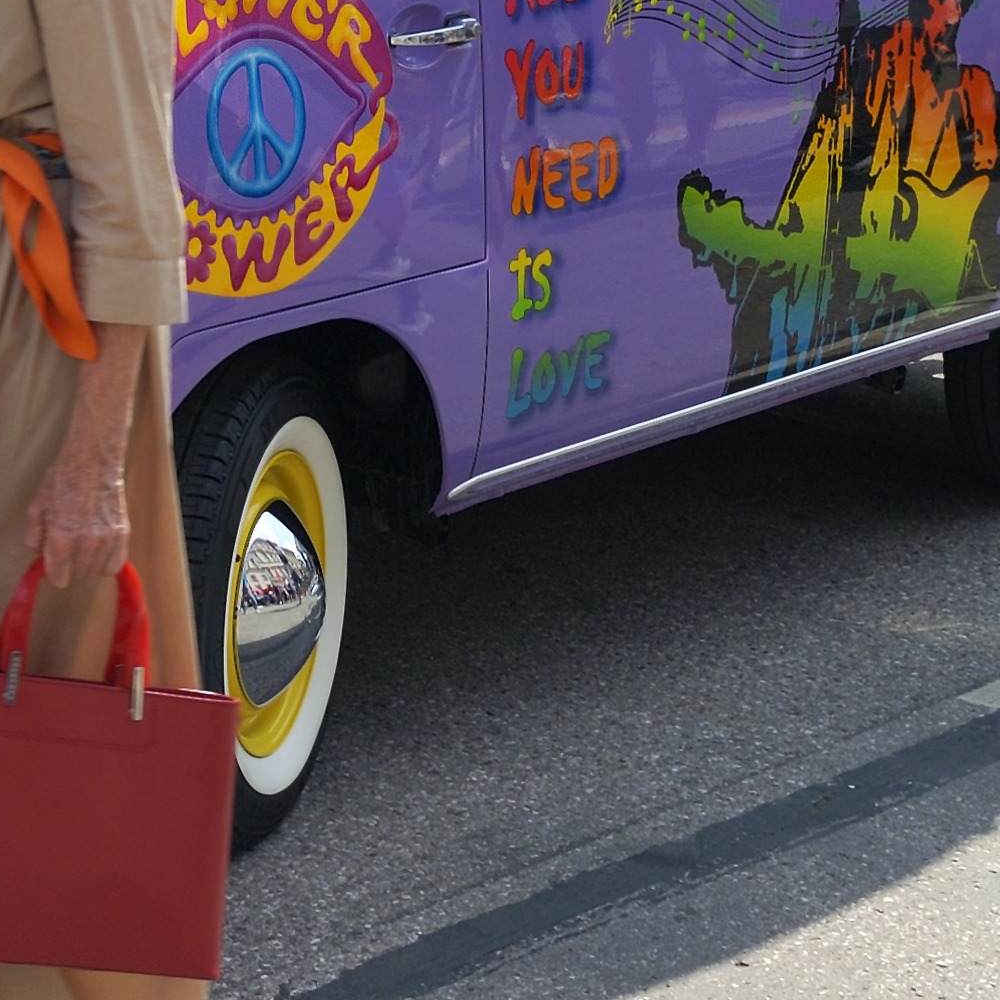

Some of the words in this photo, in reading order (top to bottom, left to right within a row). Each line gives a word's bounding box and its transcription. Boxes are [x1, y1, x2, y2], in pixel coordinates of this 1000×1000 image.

[505, 39, 585, 120] YOU
[511, 136, 619, 216] NEED
[185, 150, 398, 292] OWER
[508, 247, 553, 322] IS
[506, 330, 611, 419] LOVE
